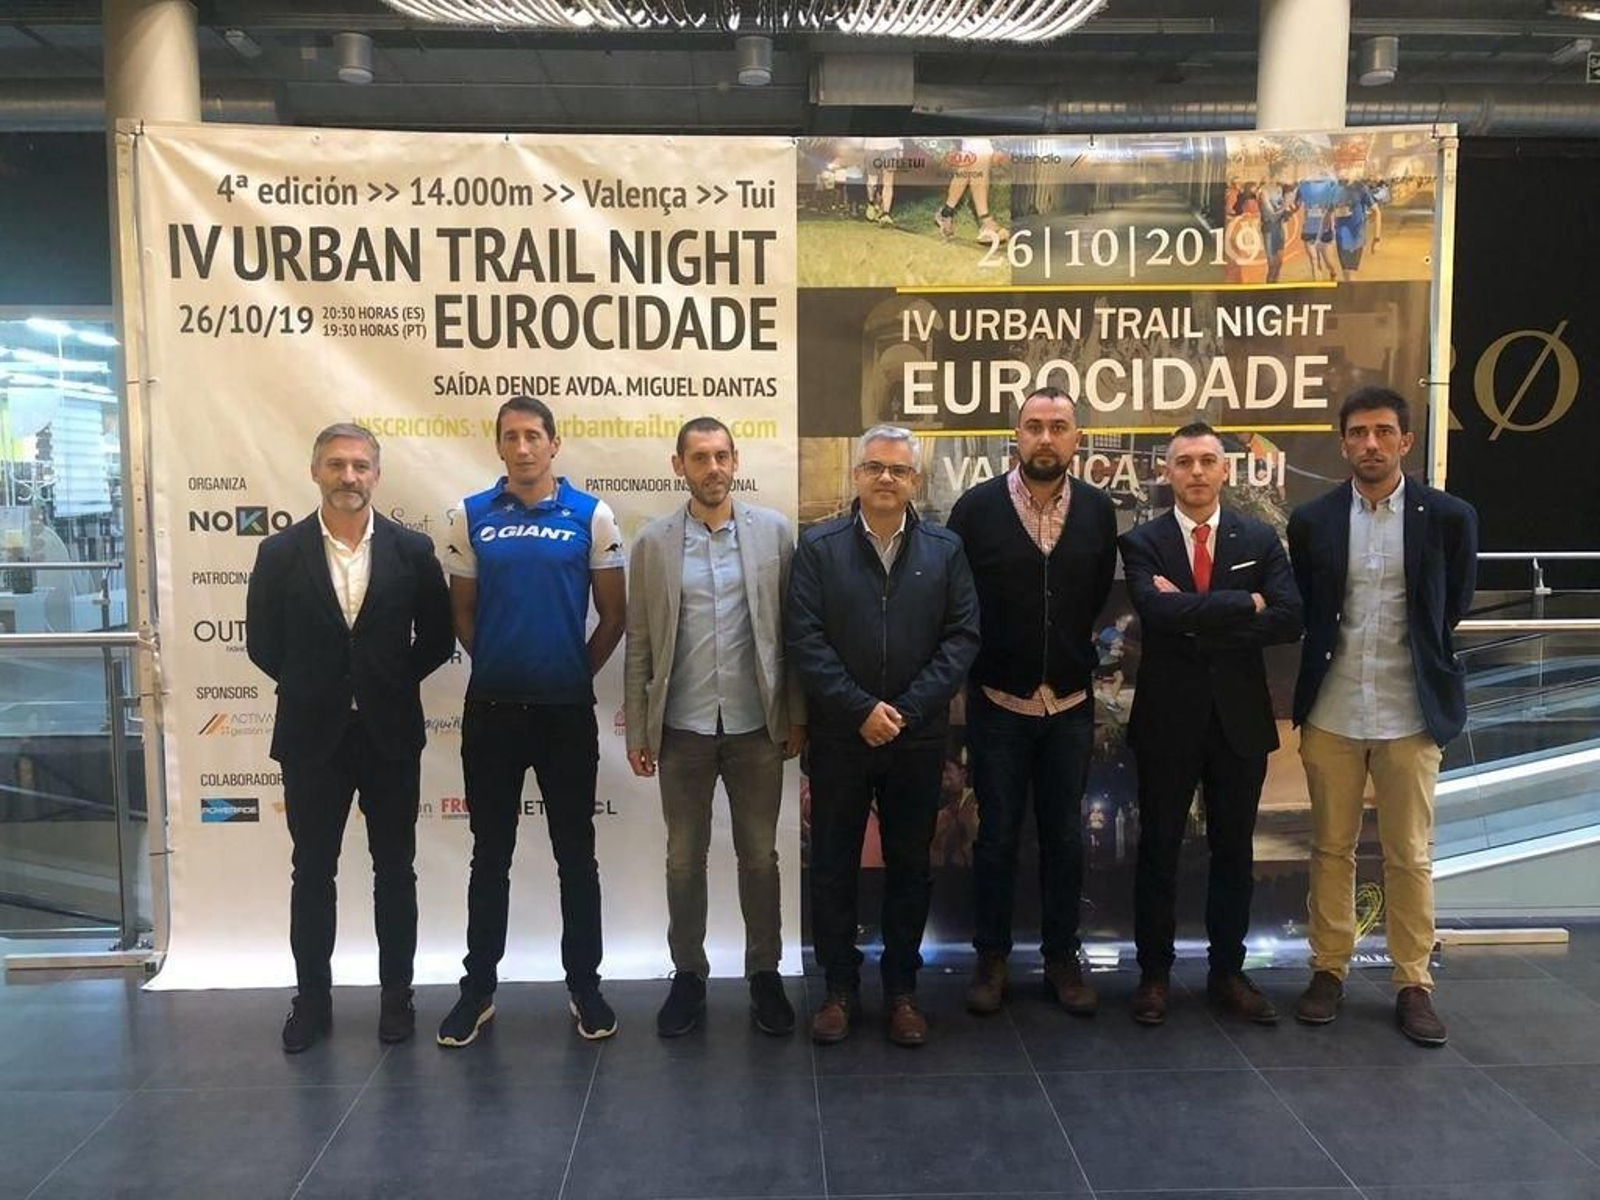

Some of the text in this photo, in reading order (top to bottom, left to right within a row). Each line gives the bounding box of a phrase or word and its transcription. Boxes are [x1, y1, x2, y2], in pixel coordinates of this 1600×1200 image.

[1012, 154, 1061, 165] blendio
[257, 176, 358, 206] edición
[410, 177, 534, 207] 14.000m
[582, 179, 687, 217] Valença
[737, 180, 776, 209] Tui
[168, 224, 777, 286] IV URBAN TRAIL NIGHT
[179, 304, 314, 337] 26/10/19
[322, 306, 426, 322] 20:30 HORAS (ES)
[435, 294, 778, 352] EUROCIDADE
[902, 304, 1331, 341] IV URBAN TRAIL NIGHT
[322, 323, 427, 340] 19:30 HORAS (PT)
[434, 372, 777, 398] SAÍDA DENDE AVDA. MIGUEL DANTAS
[903, 356, 1330, 415] EUROCIDADE
[188, 477, 247, 491] ORGANIZA
[1227, 453, 1286, 487] TUI
[586, 478, 671, 491] PATROCINADOR
[189, 506, 293, 536] NOKO
[498, 524, 576, 542] GIANT
[196, 687, 258, 699] SPONSORS
